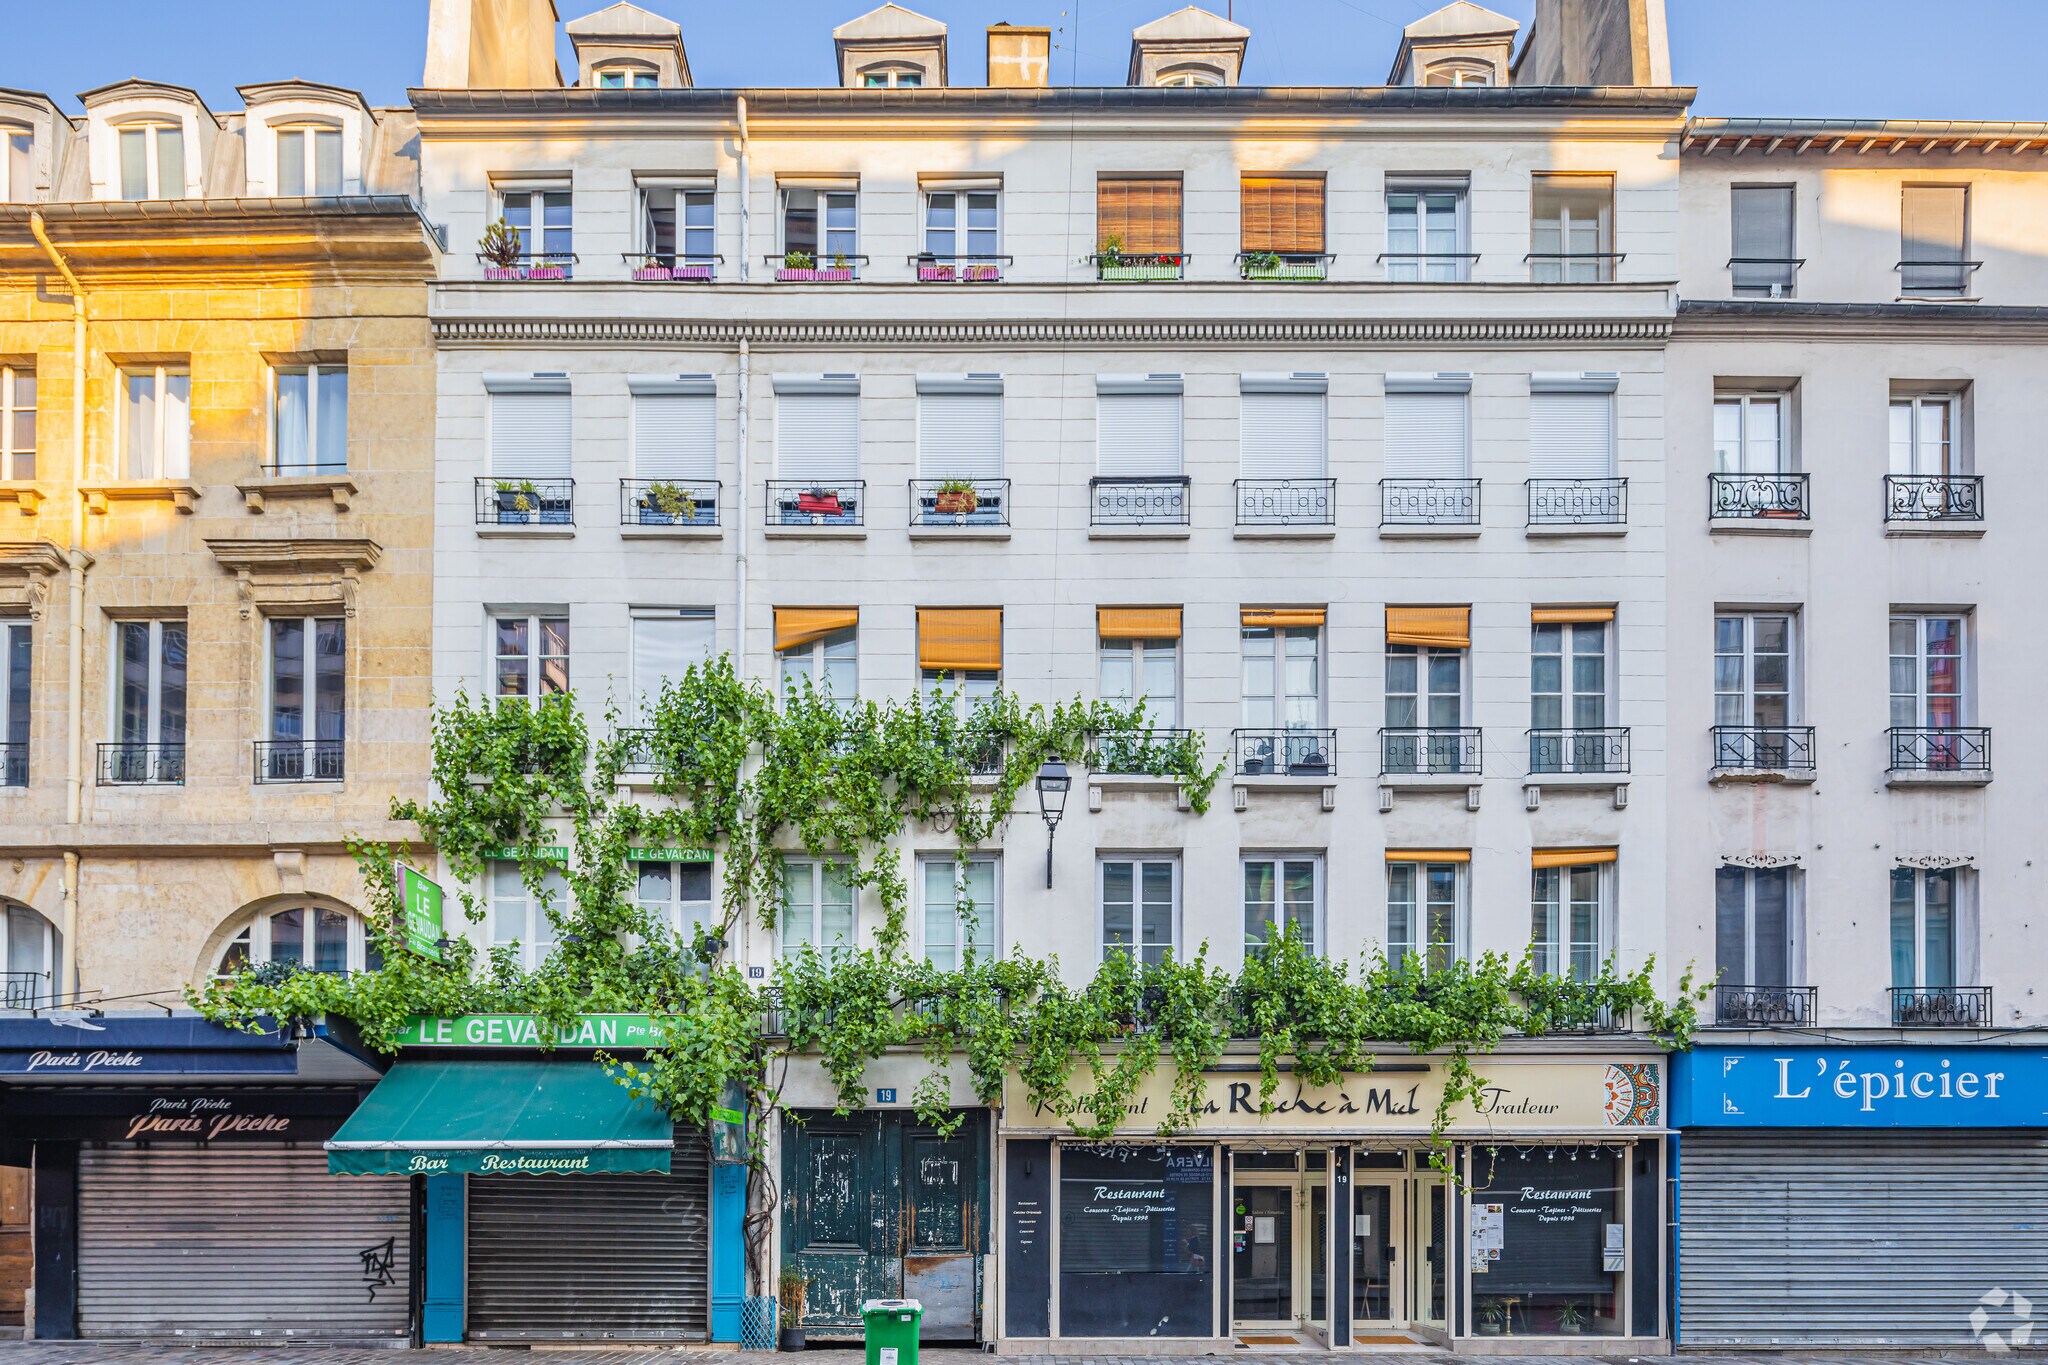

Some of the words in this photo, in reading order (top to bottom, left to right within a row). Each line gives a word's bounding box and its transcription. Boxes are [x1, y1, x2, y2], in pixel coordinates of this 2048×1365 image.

[630, 848, 645, 859] LE
[649, 848, 710, 860] GEVAUDAN
[417, 880, 429, 893] Bar
[416, 893, 430, 918] LE
[407, 910, 440, 942] GEVAUDAN
[751, 968, 762, 978] 19
[419, 1019, 453, 1043] LE
[26, 1050, 81, 1072] Paris
[83, 1050, 143, 1072] Pêche
[1773, 1057, 2005, 1112] L'épicier
[881, 1090, 892, 1101] 19
[1338, 1093, 1361, 1114] à
[1366, 1083, 1421, 1115] Miel
[1476, 1088, 1559, 1114] Traiteur
[150, 1098, 188, 1112] Paris
[190, 1098, 232, 1112] Pêche
[125, 1113, 202, 1140] Paris
[207, 1113, 291, 1140] Pêche
[408, 1155, 448, 1171] Bar
[480, 1154, 590, 1171] Restaurant
[1337, 1175, 1347, 1183] 19
[1093, 1186, 1165, 1201] Restaurant
[1520, 1187, 1592, 1202] Restaurant
[1115, 1205, 1140, 1215] Tajines
[1144, 1204, 1176, 1213] Pâtisseries
[1541, 1205, 1566, 1215] Tajines
[1571, 1205, 1602, 1213] Pâtisseries
[1111, 1214, 1132, 1223] Depuis
[1538, 1214, 1559, 1223] Depuis
